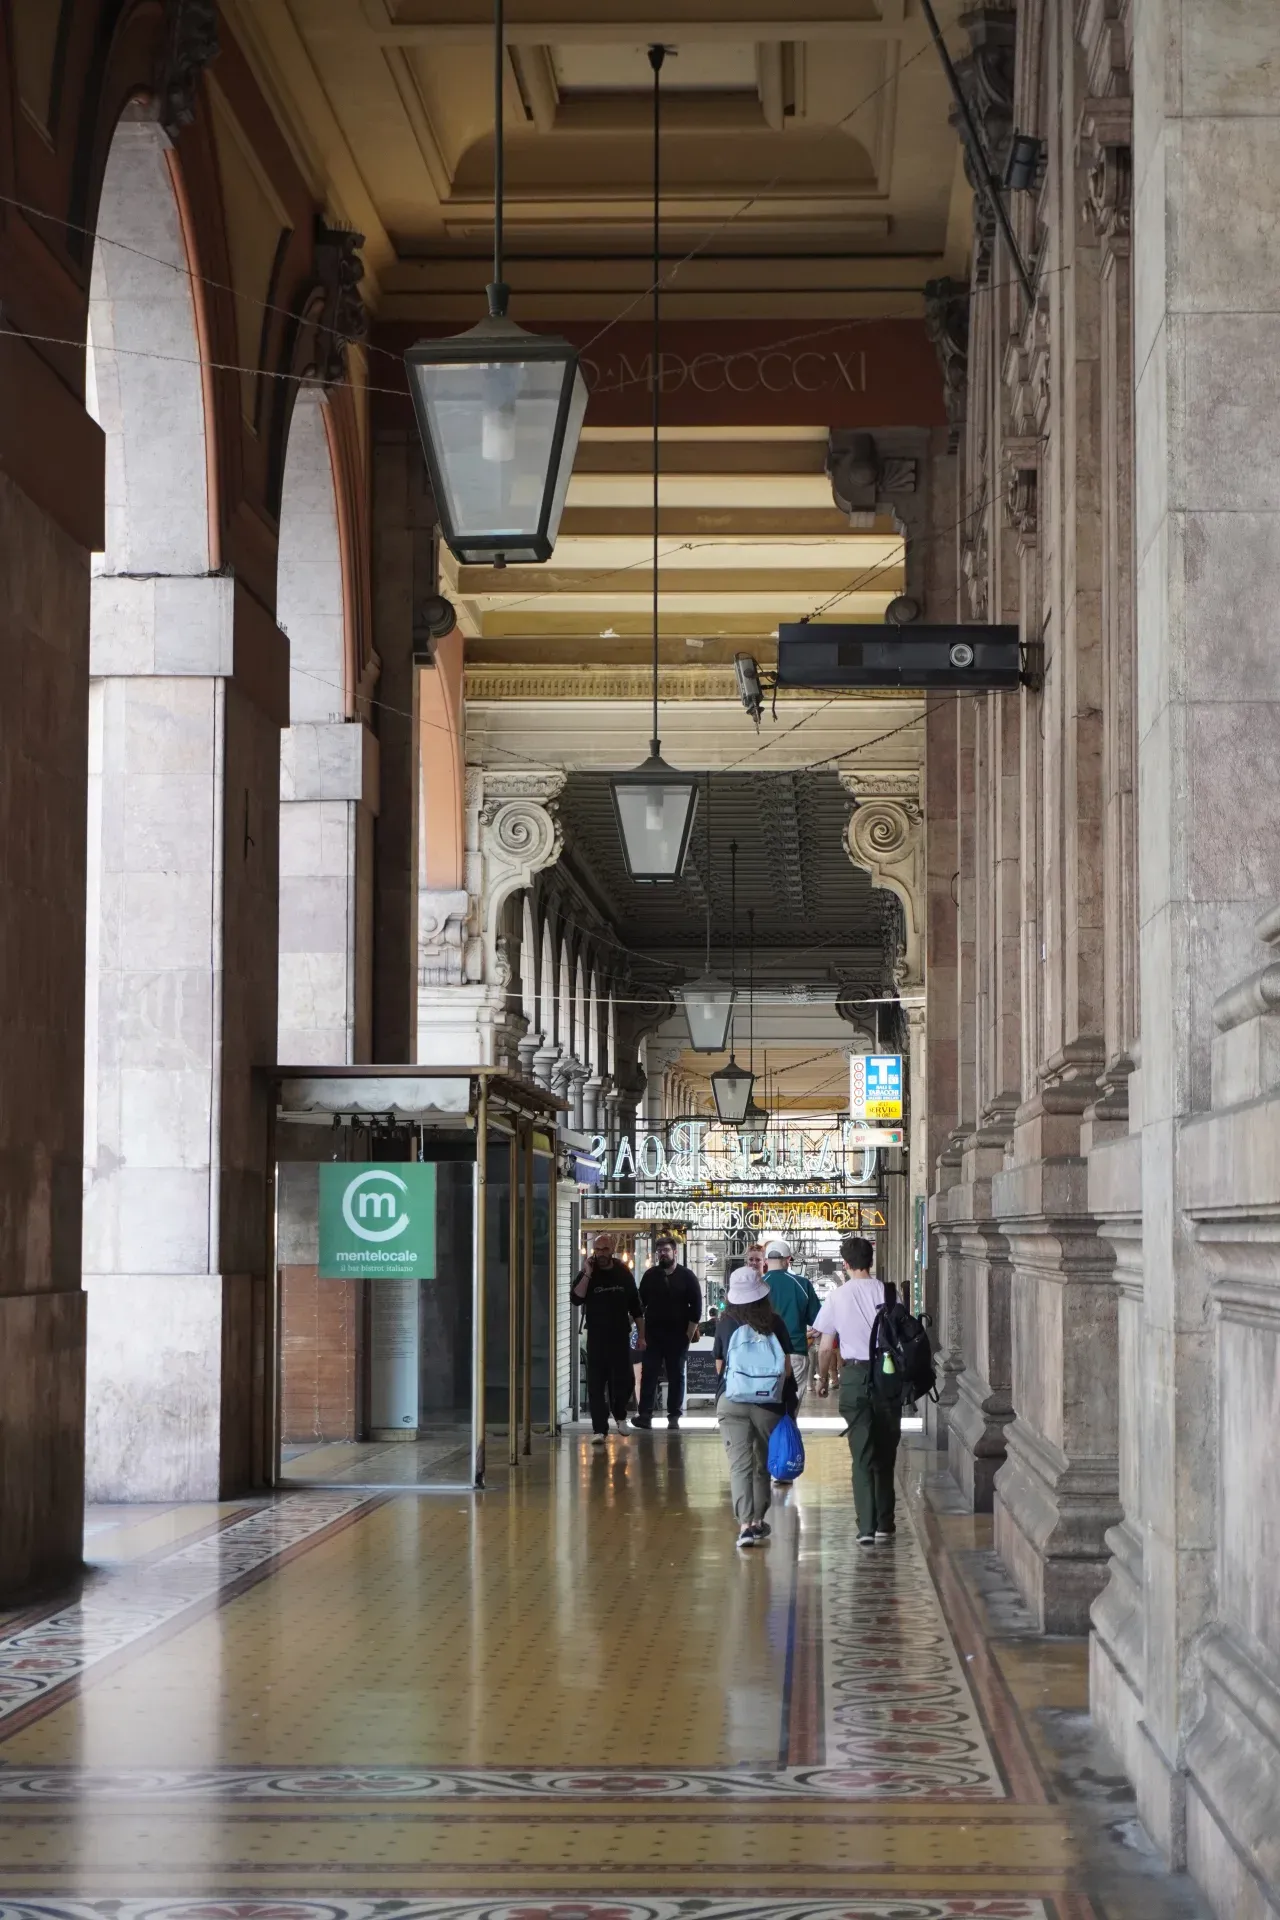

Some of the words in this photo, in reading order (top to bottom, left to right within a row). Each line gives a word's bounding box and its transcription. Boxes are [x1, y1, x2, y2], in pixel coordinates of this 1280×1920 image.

[336, 1249, 418, 1262] mentelocale
[340, 1264, 346, 1272] il
[347, 1264, 359, 1272] bar
[361, 1264, 384, 1272] bistrot
[386, 1264, 414, 1272] italiano
